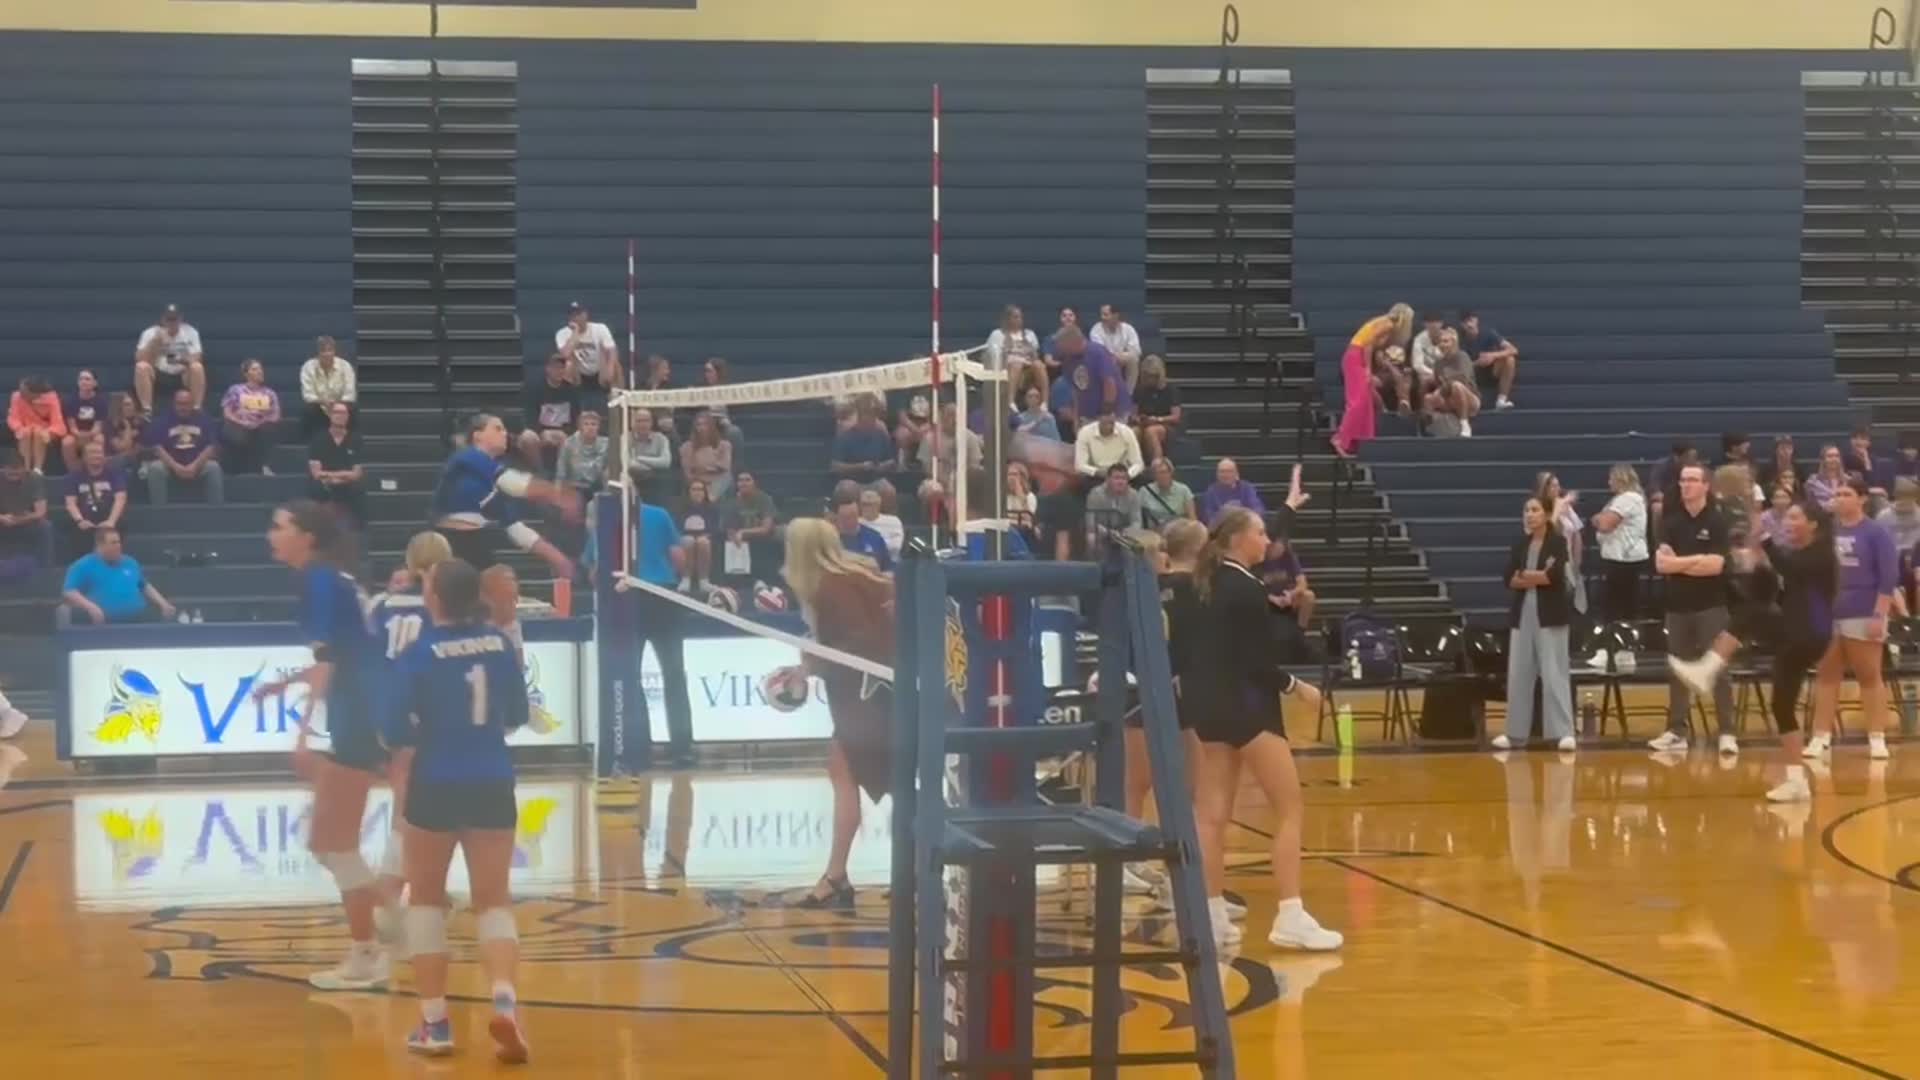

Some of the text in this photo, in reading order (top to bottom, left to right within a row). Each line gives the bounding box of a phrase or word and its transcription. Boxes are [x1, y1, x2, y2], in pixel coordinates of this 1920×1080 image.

[385, 614, 423, 660] 10
[465, 663, 488, 726] 1
[1037, 705, 1082, 724] en
